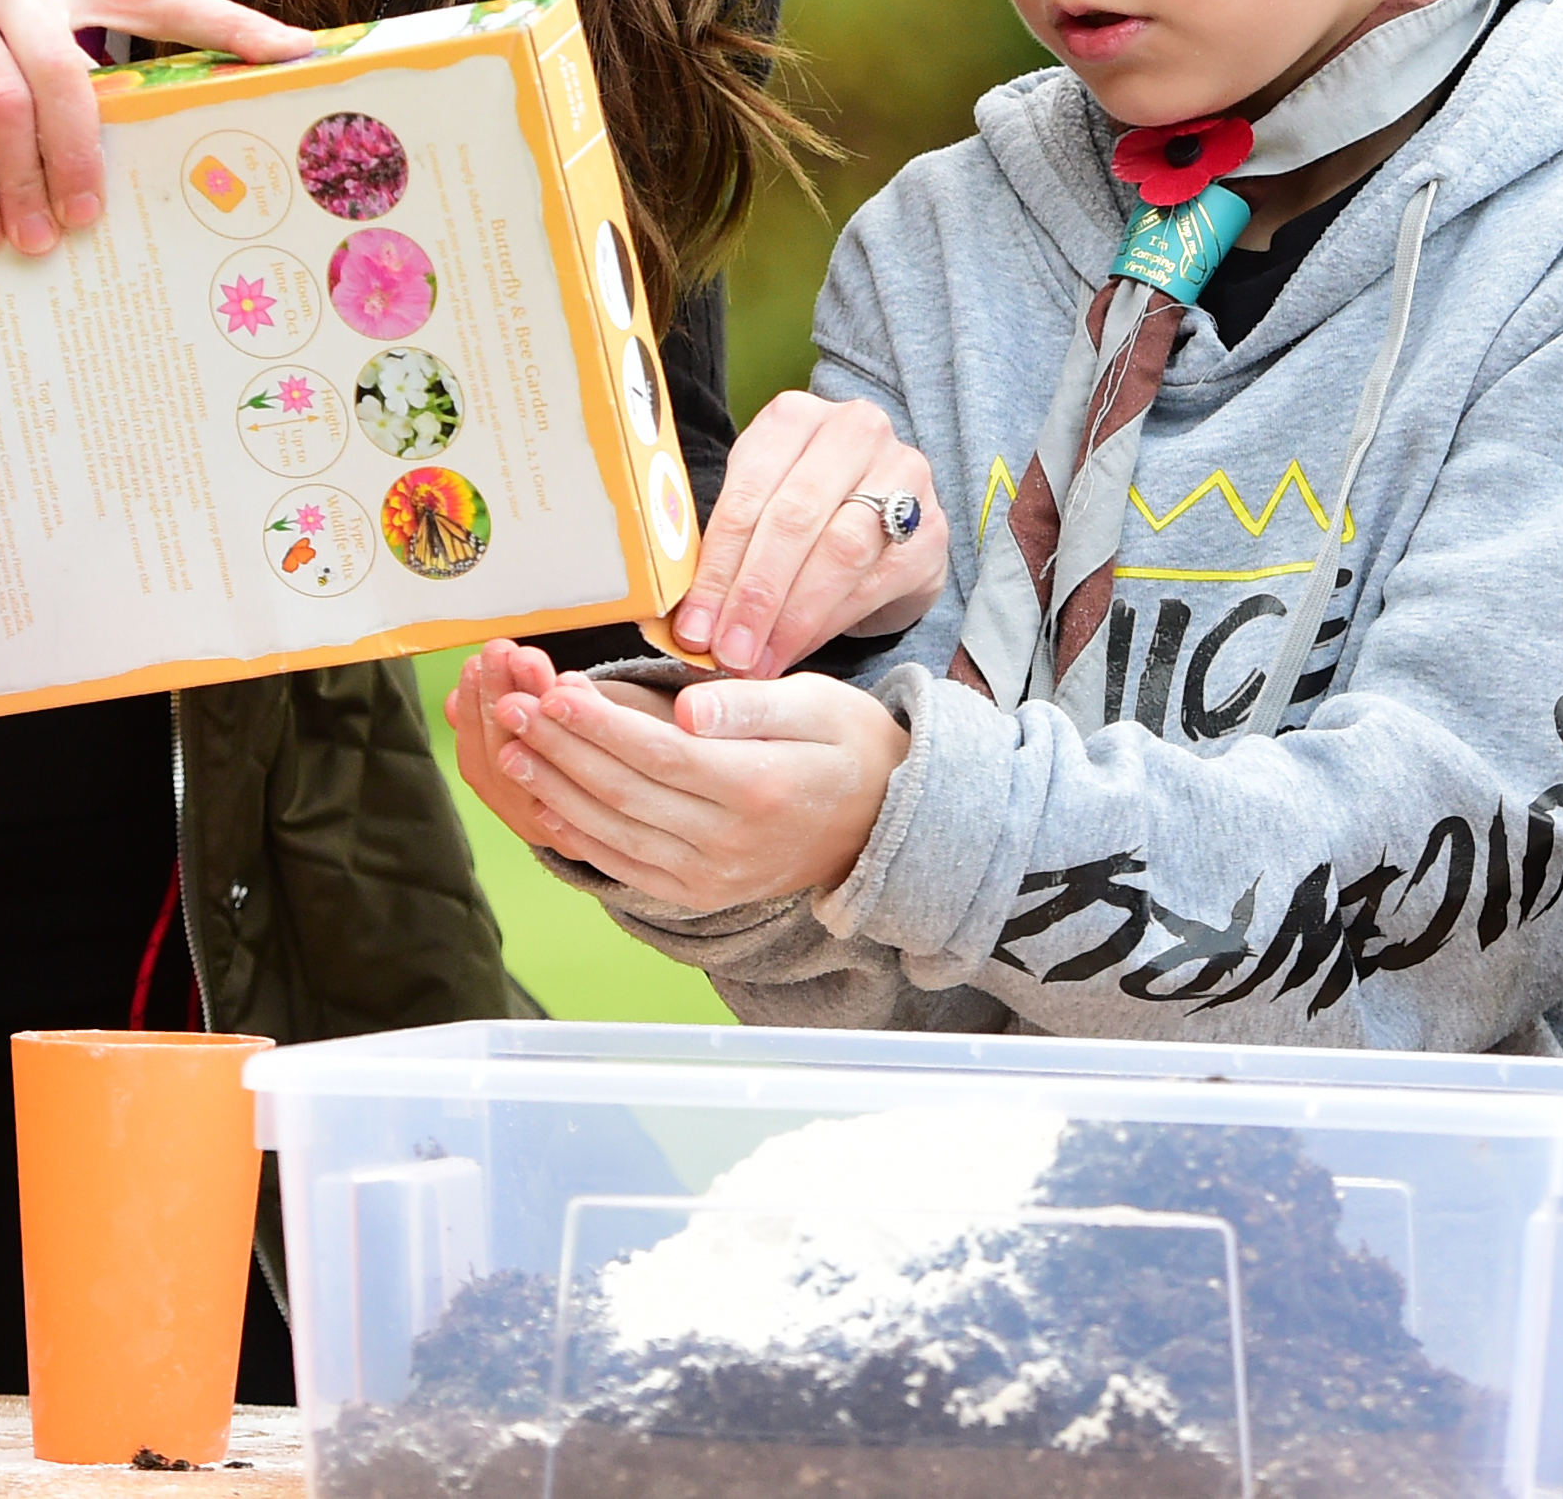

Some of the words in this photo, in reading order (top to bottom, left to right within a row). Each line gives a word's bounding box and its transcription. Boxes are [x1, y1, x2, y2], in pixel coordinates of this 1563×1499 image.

[242, 146, 259, 171] Feb
[253, 185, 270, 217] June
[265, 161, 284, 195] Sow:
[489, 217, 523, 300] Butterfly
[1131, 247, 1176, 273] Camping
[1149, 235, 1169, 251] I'm
[1124, 261, 1171, 286] Virtually
[269, 261, 289, 294] June
[283, 308, 300, 335] Oct
[293, 270, 315, 320] Bloom:
[515, 325, 536, 359] Bee
[36, 381, 54, 404] Top
[183, 343, 209, 421] Instructions:
[524, 364, 552, 431] Garden
[42, 409, 60, 436] Tips:
[318, 388, 343, 441] Height:
[275, 431, 287, 445] 70
[289, 429, 304, 447] Up
[279, 448, 291, 467] cm
[296, 449, 306, 463] to
[325, 494, 349, 550] Wildlife
[339, 554, 356, 580] Mix
[347, 516, 369, 553] Type:
